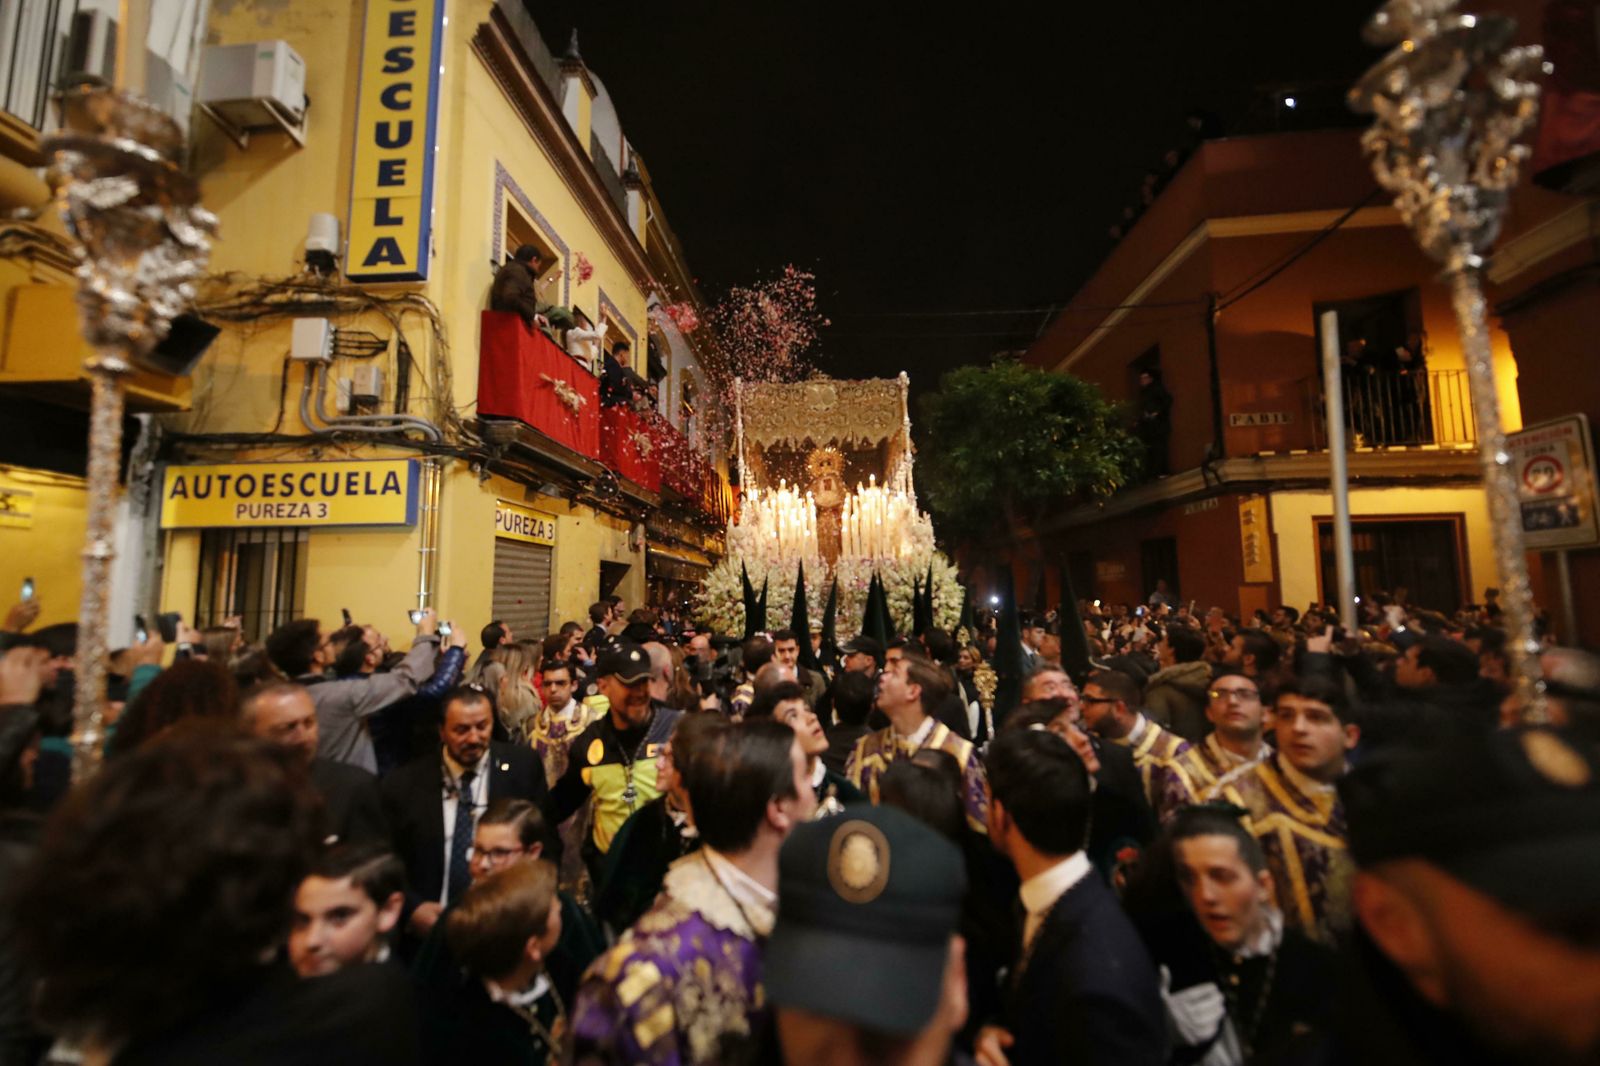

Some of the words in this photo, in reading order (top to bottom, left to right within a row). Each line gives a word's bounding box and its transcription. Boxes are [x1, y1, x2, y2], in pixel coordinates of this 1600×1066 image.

[362, 0, 417, 267] ESCUELA
[169, 470, 402, 500] AUTOESCUELA
[236, 503, 312, 519] PUREZA
[317, 503, 328, 518] 3
[496, 509, 545, 538] PUREZA
[547, 523, 554, 540] 3
